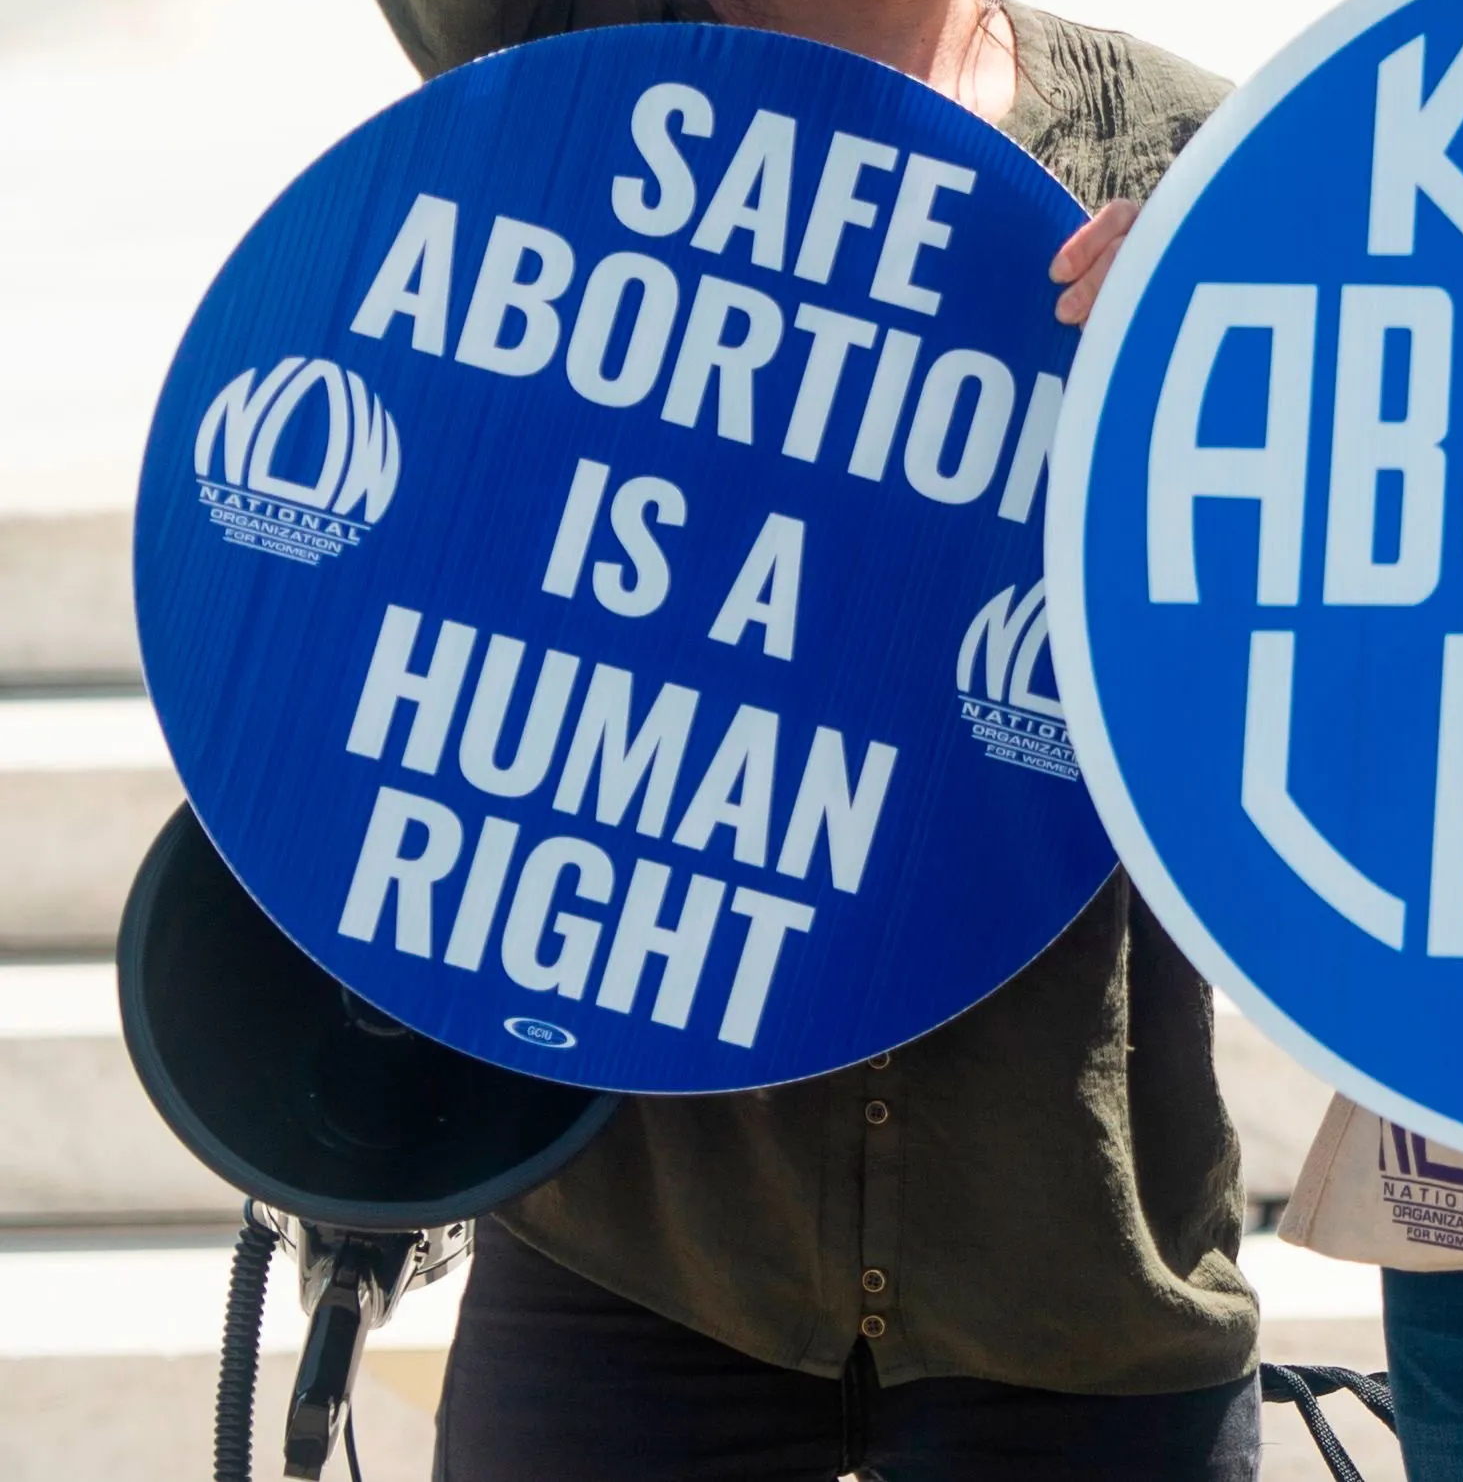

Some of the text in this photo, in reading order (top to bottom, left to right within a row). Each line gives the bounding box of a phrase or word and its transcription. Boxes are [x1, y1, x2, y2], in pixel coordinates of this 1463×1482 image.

[611, 82, 977, 317] SAFE
[194, 356, 401, 524] NOW
[199, 485, 361, 542] NATIONAL
[210, 508, 343, 553] ORGANIZATION
[224, 528, 320, 562] FOR WOMEN
[541, 458, 686, 618] IS
[708, 512, 805, 662] A
[961, 701, 1066, 743] NATIO
[972, 724, 1076, 763] ORGANIZAT
[346, 604, 898, 894] HUMAN
[985, 744, 1080, 777] FOR WOMEN
[338, 786, 816, 1049] RIGHT
[1406, 1226, 1430, 1240] FOR
